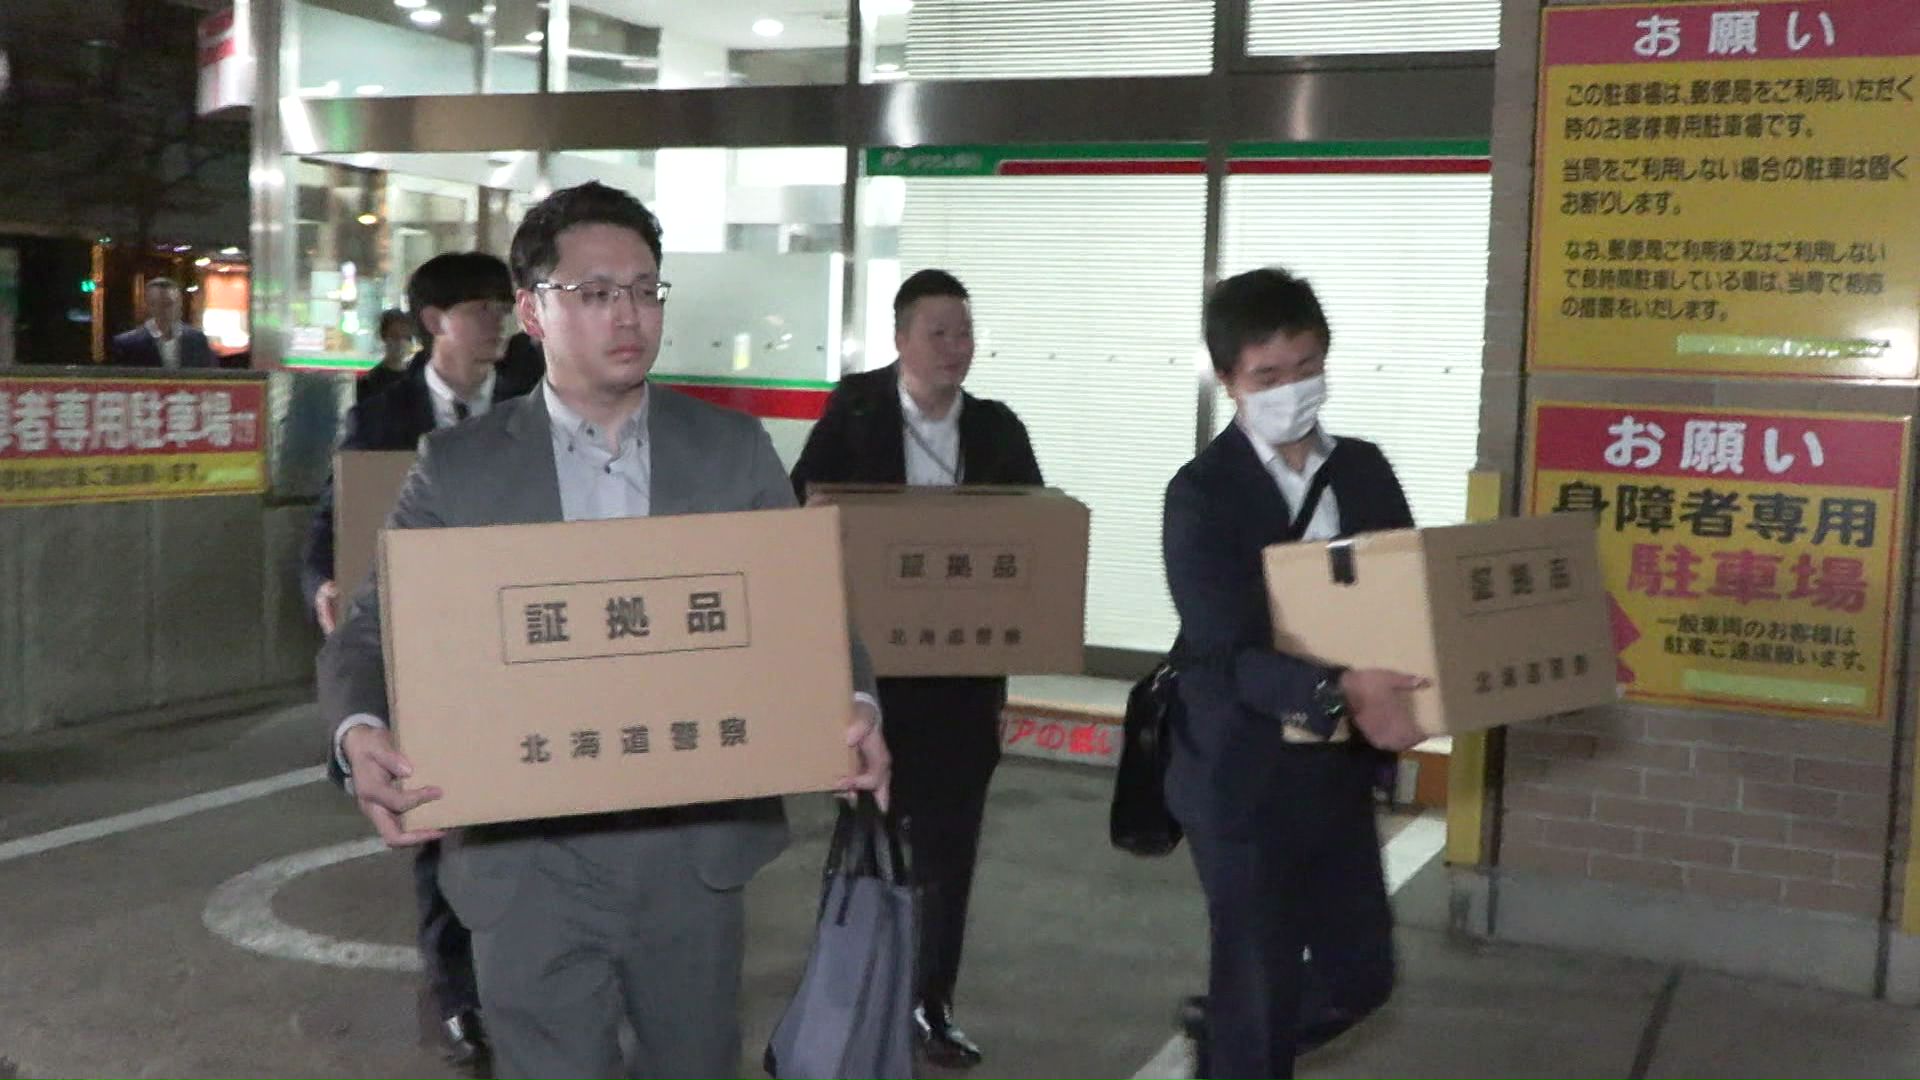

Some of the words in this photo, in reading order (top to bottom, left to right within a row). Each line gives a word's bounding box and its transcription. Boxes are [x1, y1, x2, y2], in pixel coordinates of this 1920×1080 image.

[1634, 11, 1836, 57] お願い
[1565, 113, 1815, 140] 時のお客様専用駐車場です。
[1561, 191, 1682, 216] お断りします。
[1604, 415, 1825, 474] お願い
[1553, 480, 1877, 548] 身障者専用
[1626, 542, 1869, 614] 駐車場
[524, 591, 727, 645] 証拠品
[520, 717, 747, 764] 北海道警察
